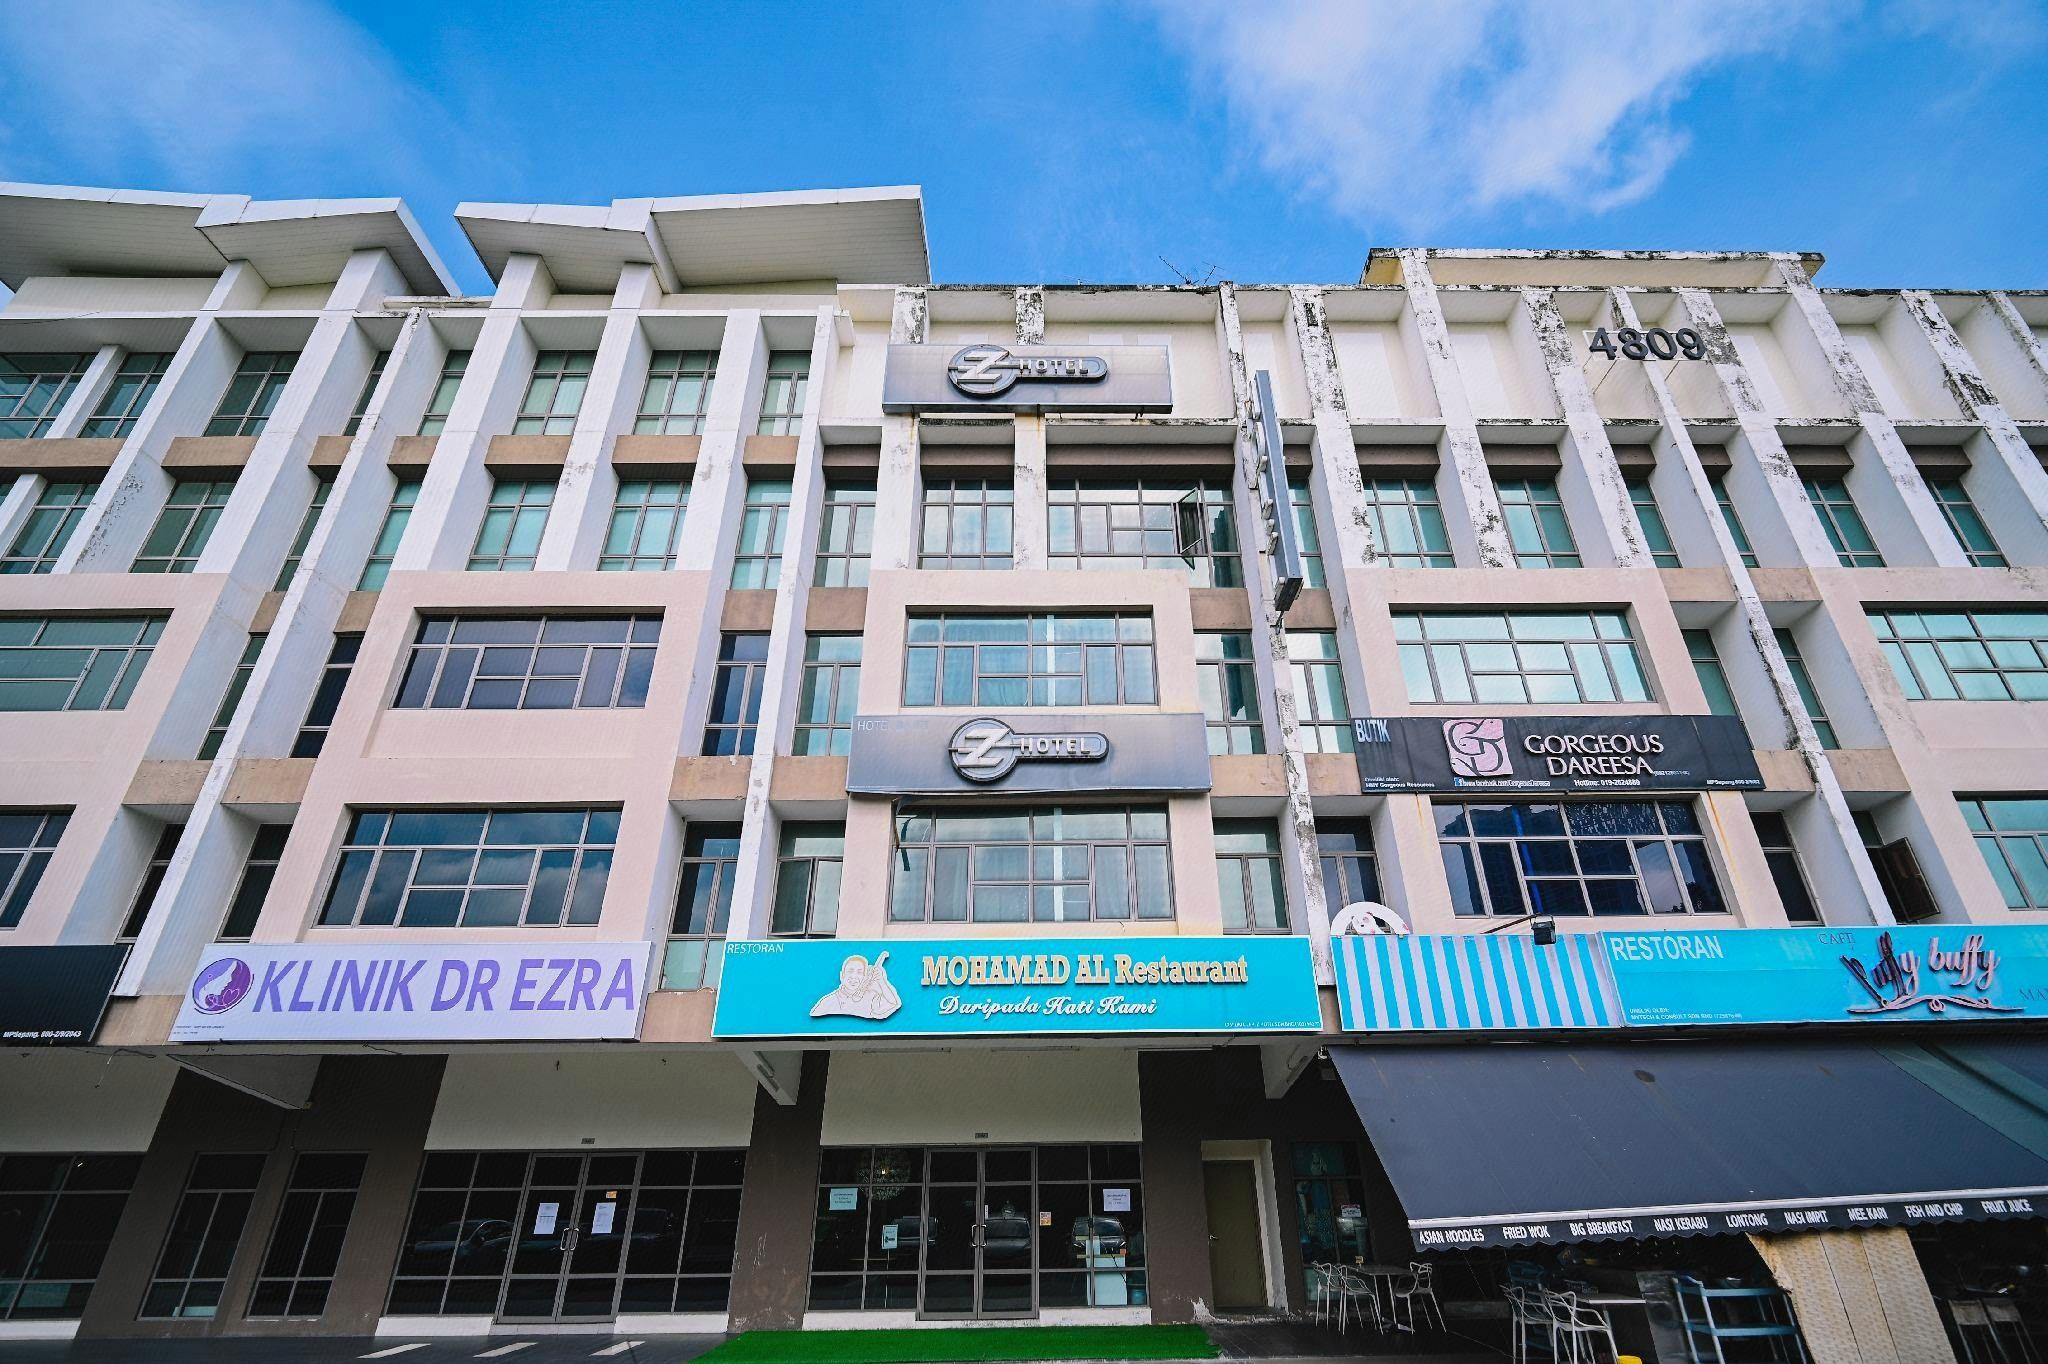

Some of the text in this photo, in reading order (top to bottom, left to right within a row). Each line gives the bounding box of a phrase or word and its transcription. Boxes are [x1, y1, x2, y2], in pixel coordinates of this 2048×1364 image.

[1589, 327, 1707, 360] 4809
[1019, 358, 1089, 375] HOTEL
[1355, 719, 1391, 743] BUTIK
[1020, 737, 1091, 754] HOTEL
[1524, 734, 1665, 754] GORGEOUS
[1546, 756, 1653, 776] DAREESA
[726, 943, 784, 954] RESTORAN
[1609, 935, 1725, 961] RESTORAN
[921, 954, 1249, 986] MOHAMAD AL Restaurant
[1929, 934, 2000, 990] buffy
[252, 958, 634, 1012] KLINIK DR EZRA
[938, 995, 1158, 1019] Daripada Hati Kami
[1847, 1206, 1889, 1222] MEE KARI
[1904, 1203, 1964, 1218] FISH AND CHIP
[1981, 1199, 2034, 1214] FRUIT JUICE
[1654, 1216, 1708, 1232] NASI KERABU
[1725, 1212, 1768, 1228] LONTONG
[1784, 1210, 1828, 1225] NASI IMPIT
[1419, 1228, 1484, 1244] ASIAN NOODLES
[1502, 1225, 1550, 1240] FRIED WOK
[1569, 1219, 1633, 1236] BIG BREAKFAST
